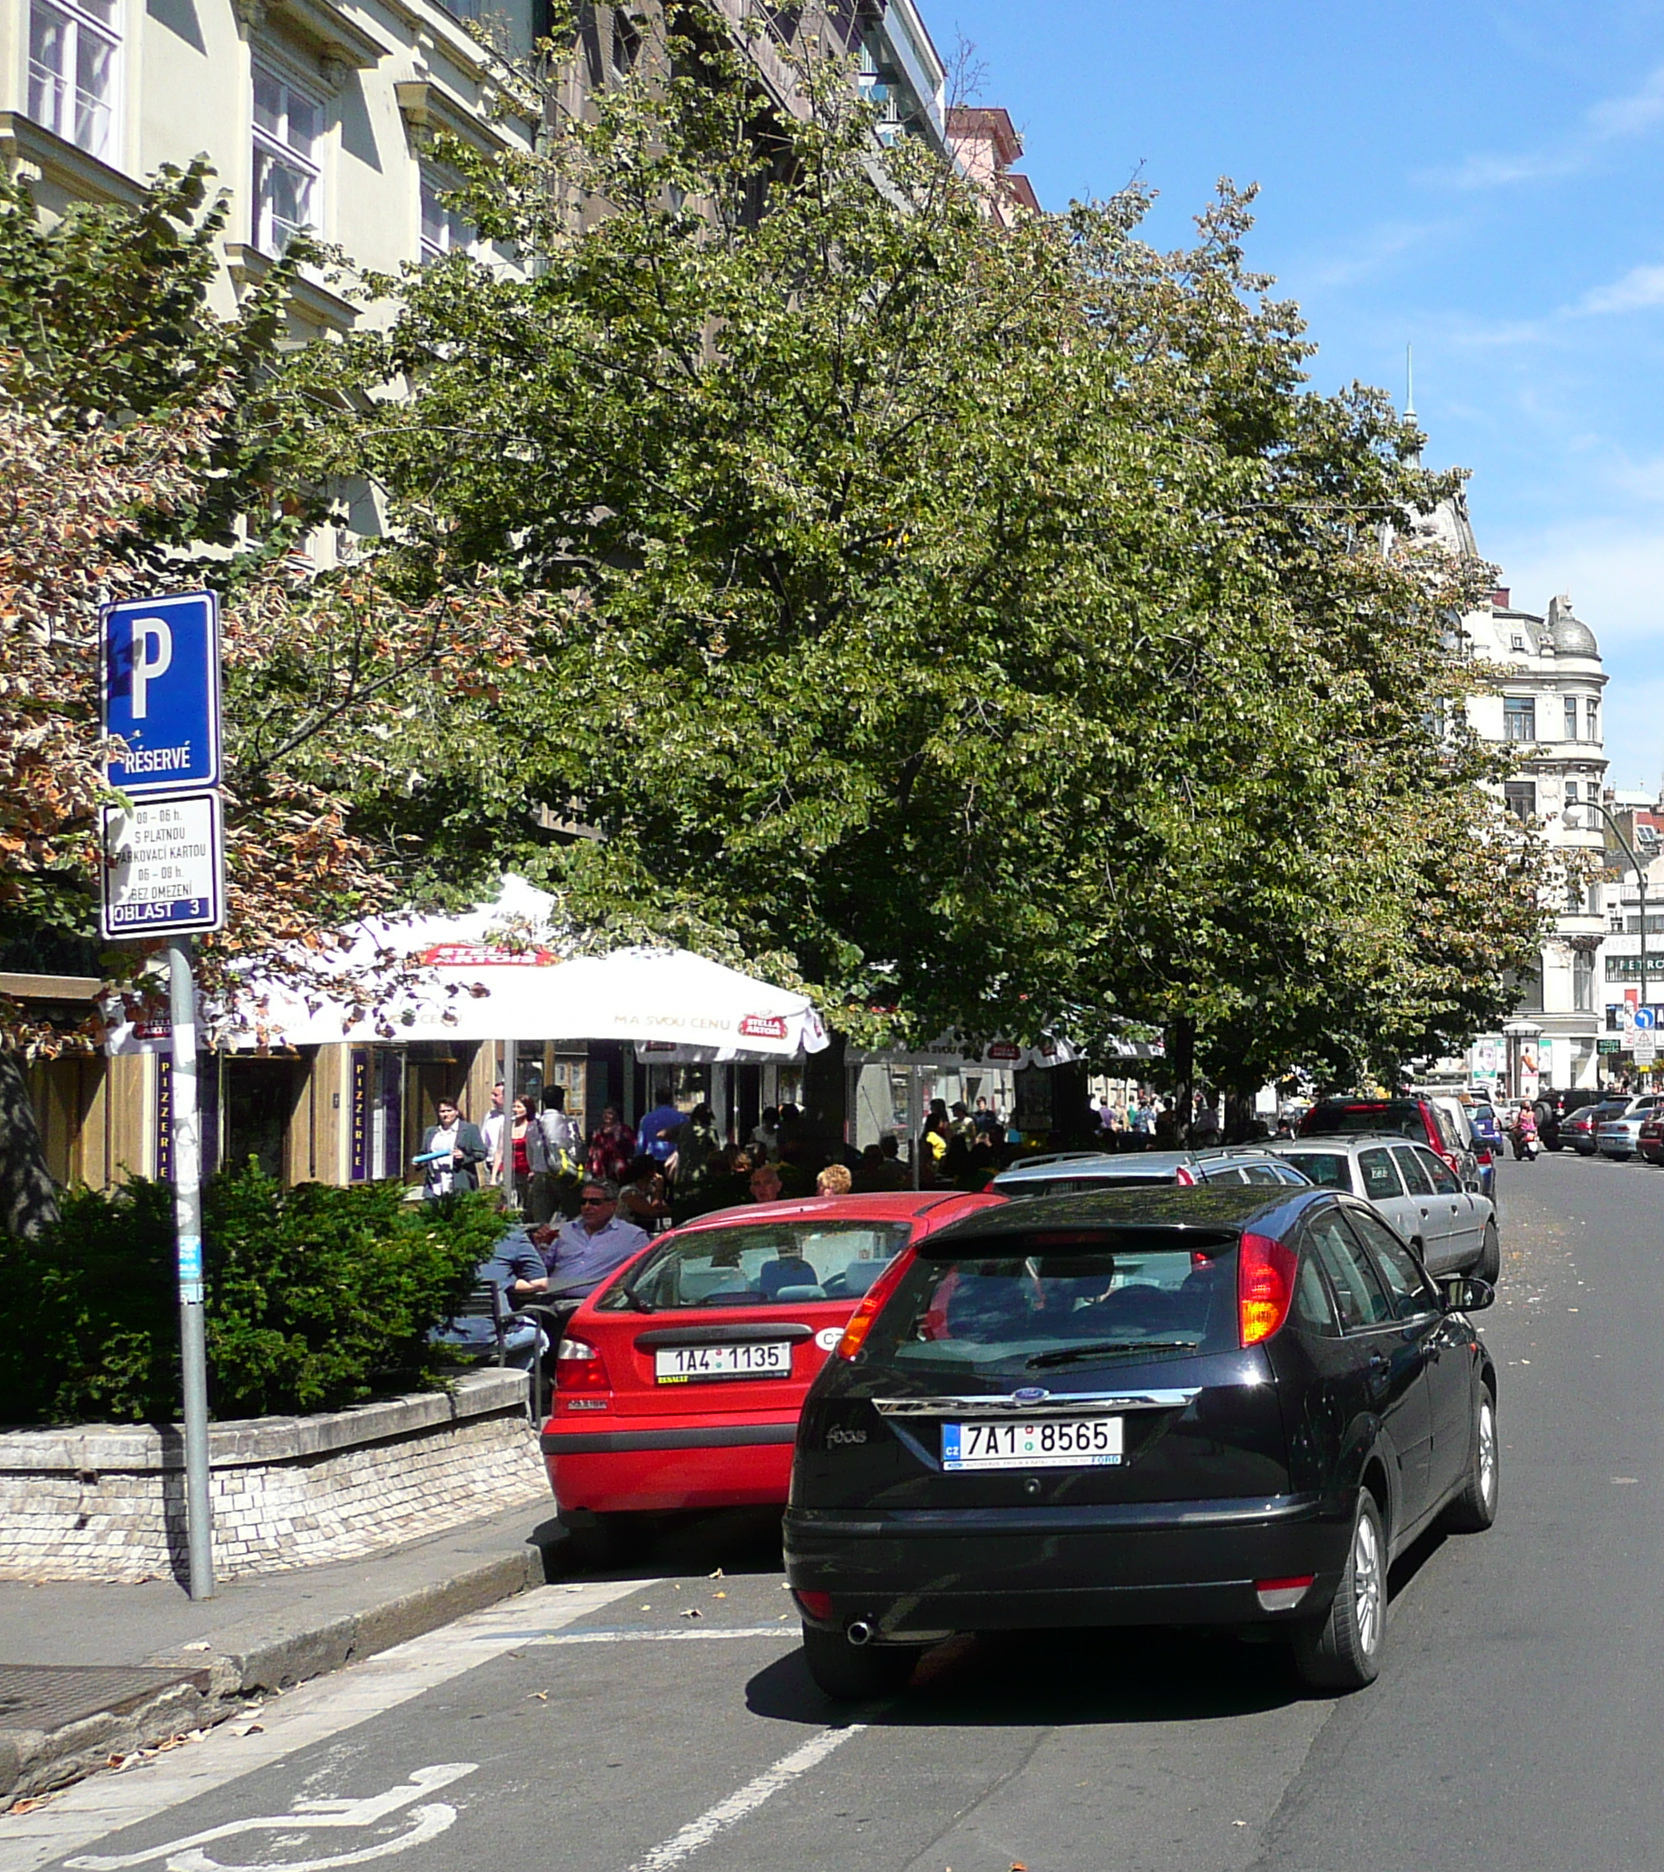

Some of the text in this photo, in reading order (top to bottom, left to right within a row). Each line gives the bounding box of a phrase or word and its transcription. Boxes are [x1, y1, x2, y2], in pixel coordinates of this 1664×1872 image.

[132, 617, 173, 719] P
[124, 740, 191, 774] RÉSERVÉ
[134, 827, 186, 844] S PLATNOU
[169, 844, 206, 860] KARTOU
[131, 881, 193, 901] BEZ OMEZENÍ
[114, 900, 200, 922] OBLAST 3
[142, 1026, 172, 1034] ARTO
[646, 1016, 685, 1027] SVOU
[690, 1019, 731, 1031] CENU
[746, 1018, 781, 1028] STELLA
[160, 1062, 171, 1178] PIZZERIE
[354, 1064, 364, 1166] PIZZERIE
[674, 1345, 780, 1373] 1A4 1135
[967, 1422, 1110, 1456] 7A1 8565
[945, 1446, 959, 1456] CZ
[1091, 1455, 1119, 1465] FORD
